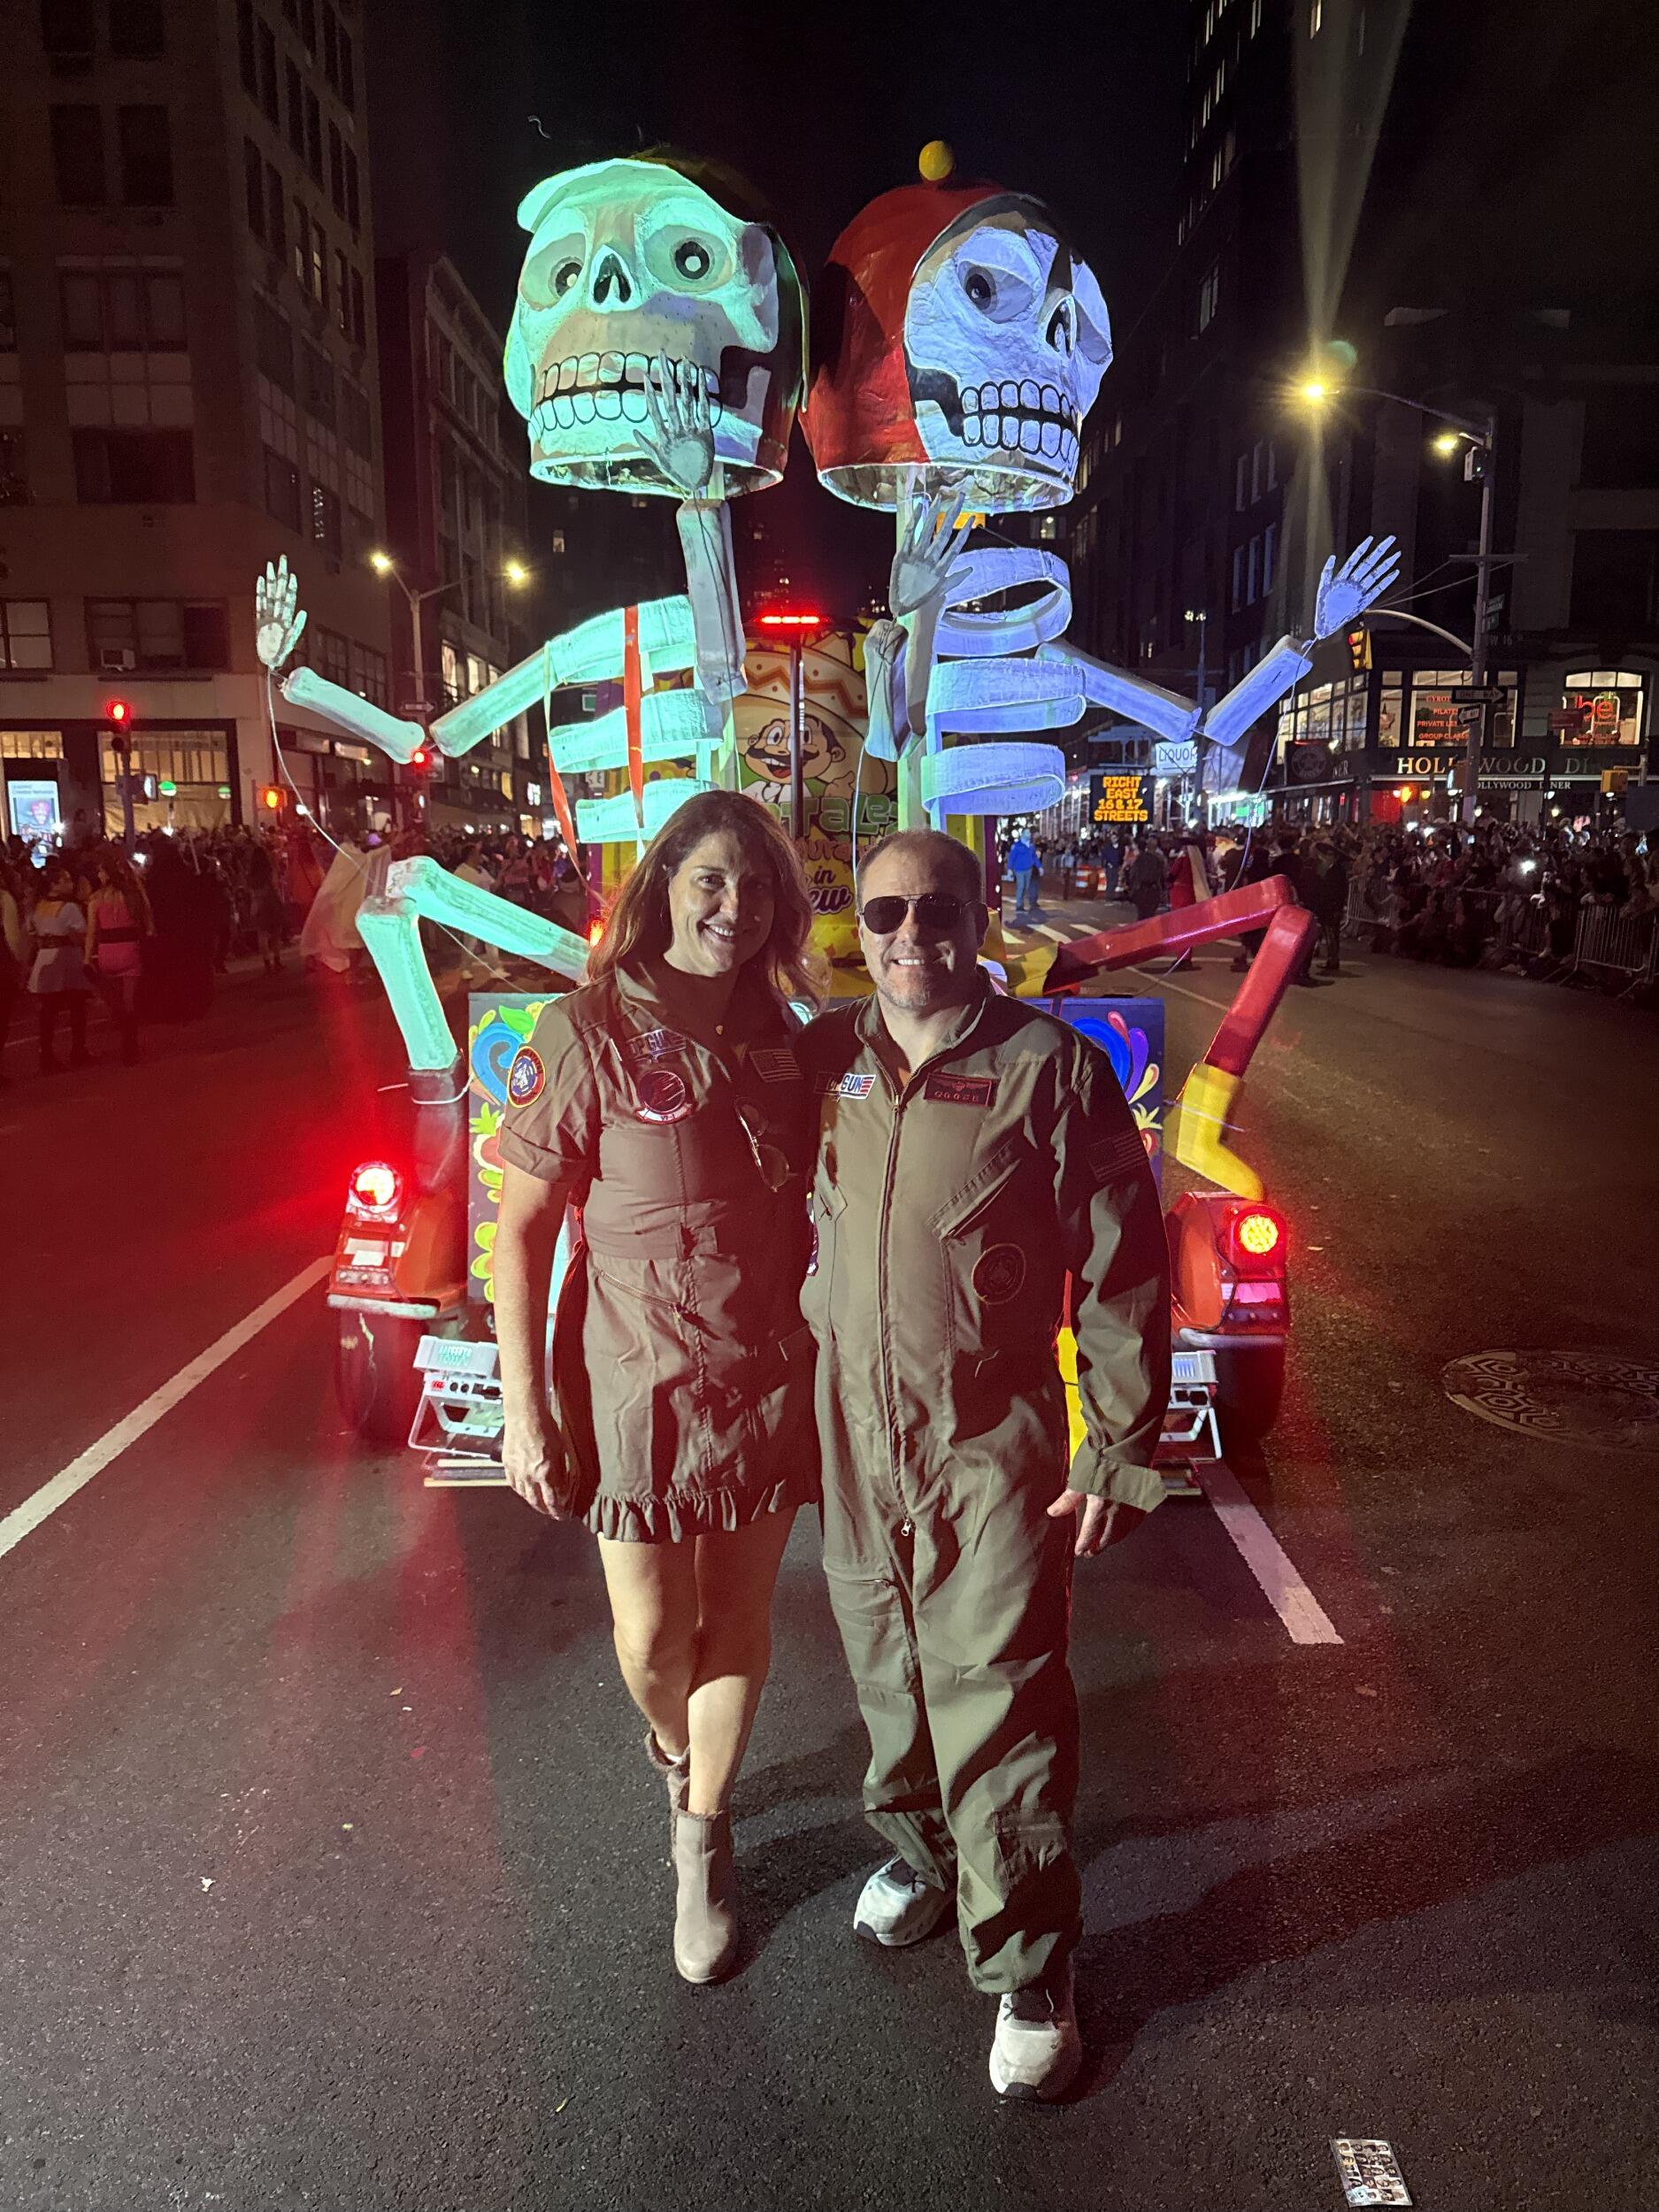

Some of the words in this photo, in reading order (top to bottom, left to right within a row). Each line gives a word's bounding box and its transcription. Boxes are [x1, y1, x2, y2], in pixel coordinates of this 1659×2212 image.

[1102, 776, 1142, 788] RIGHT
[1106, 787, 1139, 799] EAST
[1098, 799, 1115, 810] 16
[1126, 799, 1143, 810] 17
[1094, 809, 1148, 822] STREETS
[814, 865, 836, 884] in
[810, 886, 852, 912] ew
[841, 1074, 863, 1094] GUN
